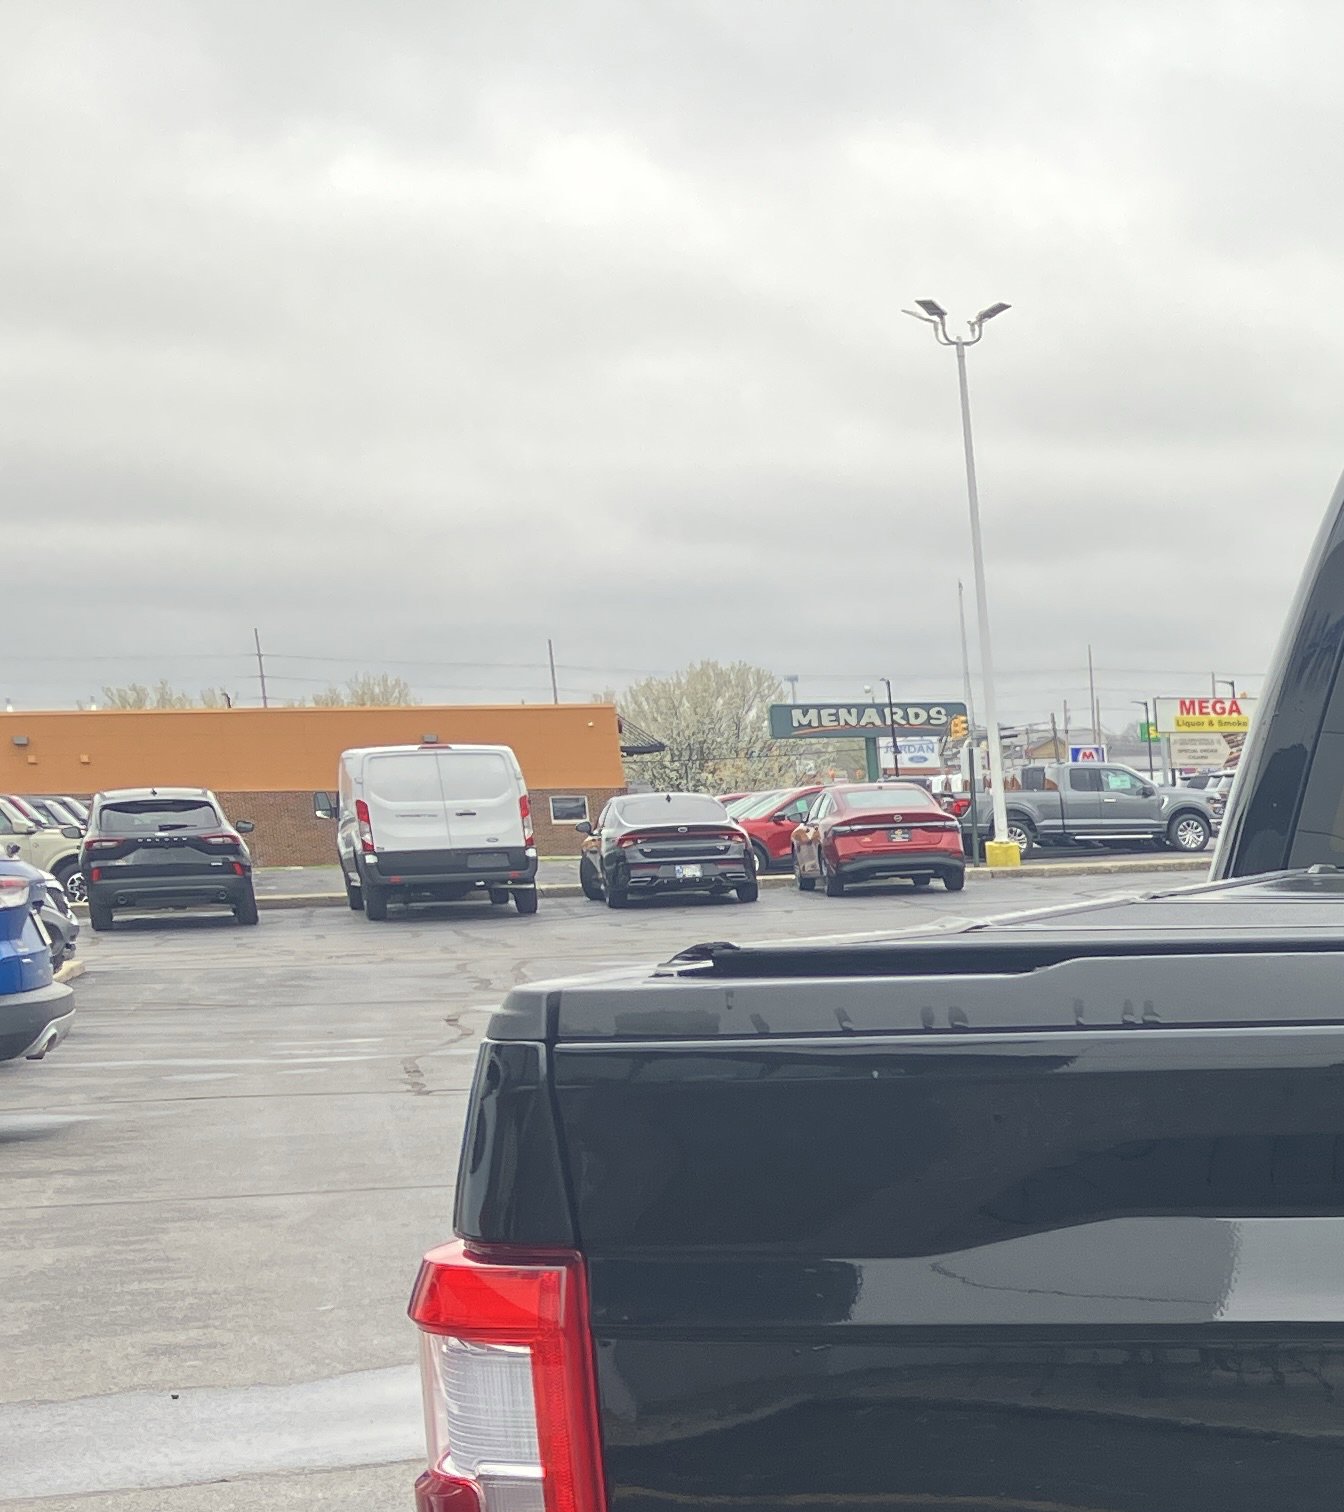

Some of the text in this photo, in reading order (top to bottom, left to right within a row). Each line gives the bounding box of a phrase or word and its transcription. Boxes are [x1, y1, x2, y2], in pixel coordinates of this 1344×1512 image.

[1179, 699, 1242, 716] MEGA
[791, 706, 948, 728] MENARDS
[1177, 719, 1204, 728] Liquor
[1218, 719, 1248, 728] Smoke
